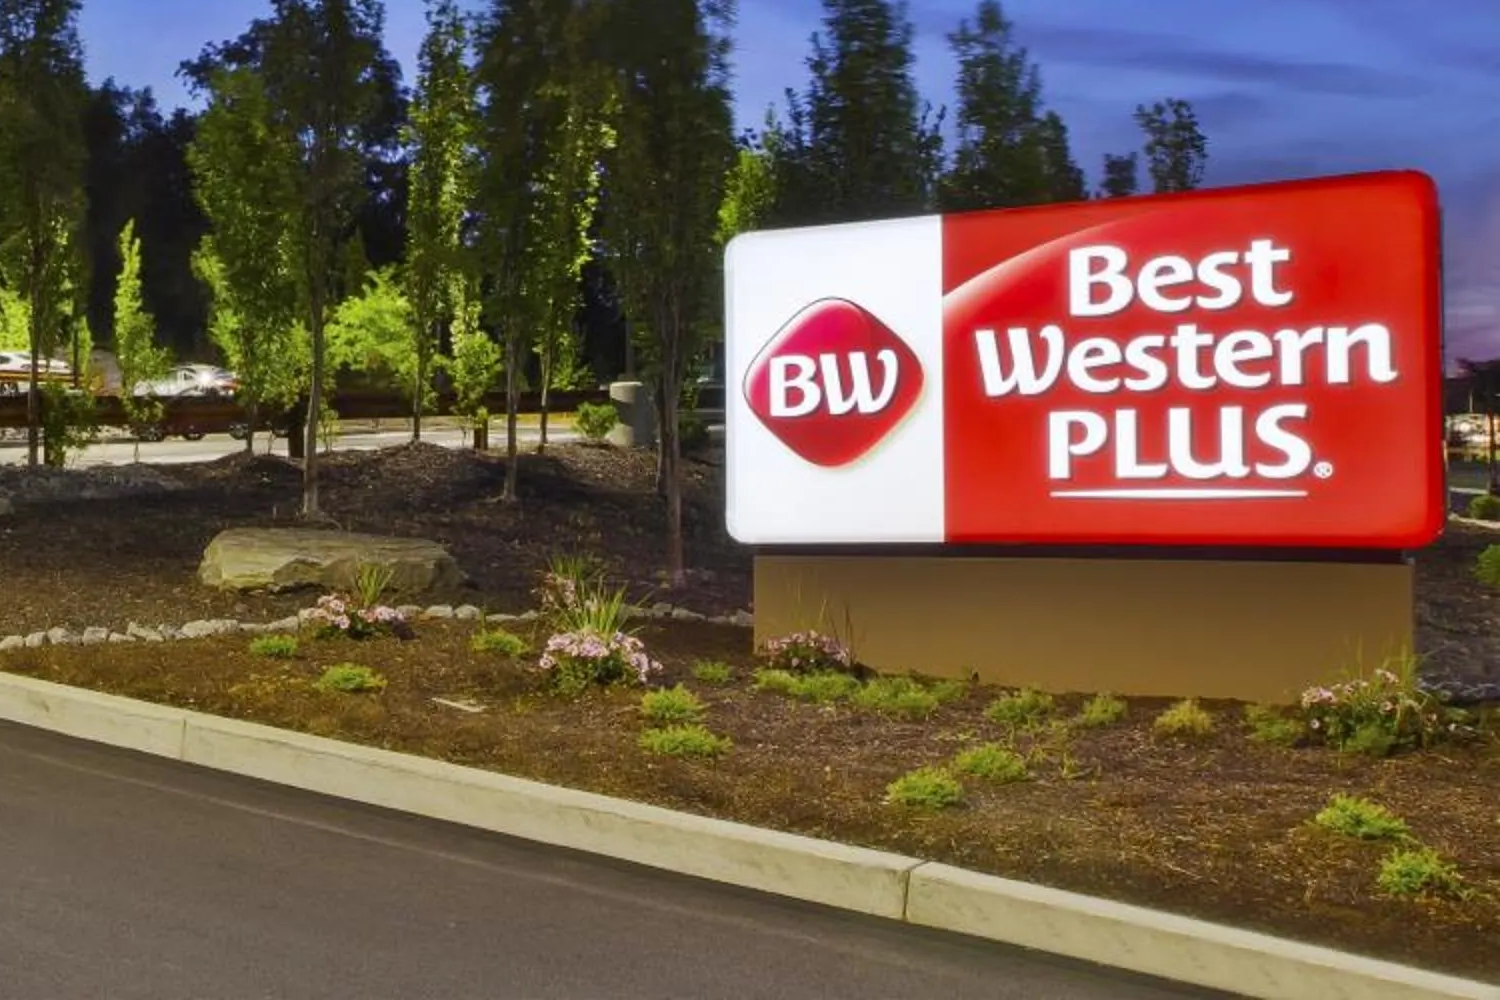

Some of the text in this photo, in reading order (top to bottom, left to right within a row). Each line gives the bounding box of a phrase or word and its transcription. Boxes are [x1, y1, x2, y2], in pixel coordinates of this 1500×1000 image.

[1069, 239, 1293, 317] Best
[769, 349, 898, 417] BW
[976, 322, 1398, 396] Western
[1049, 403, 1311, 480] PLUS
